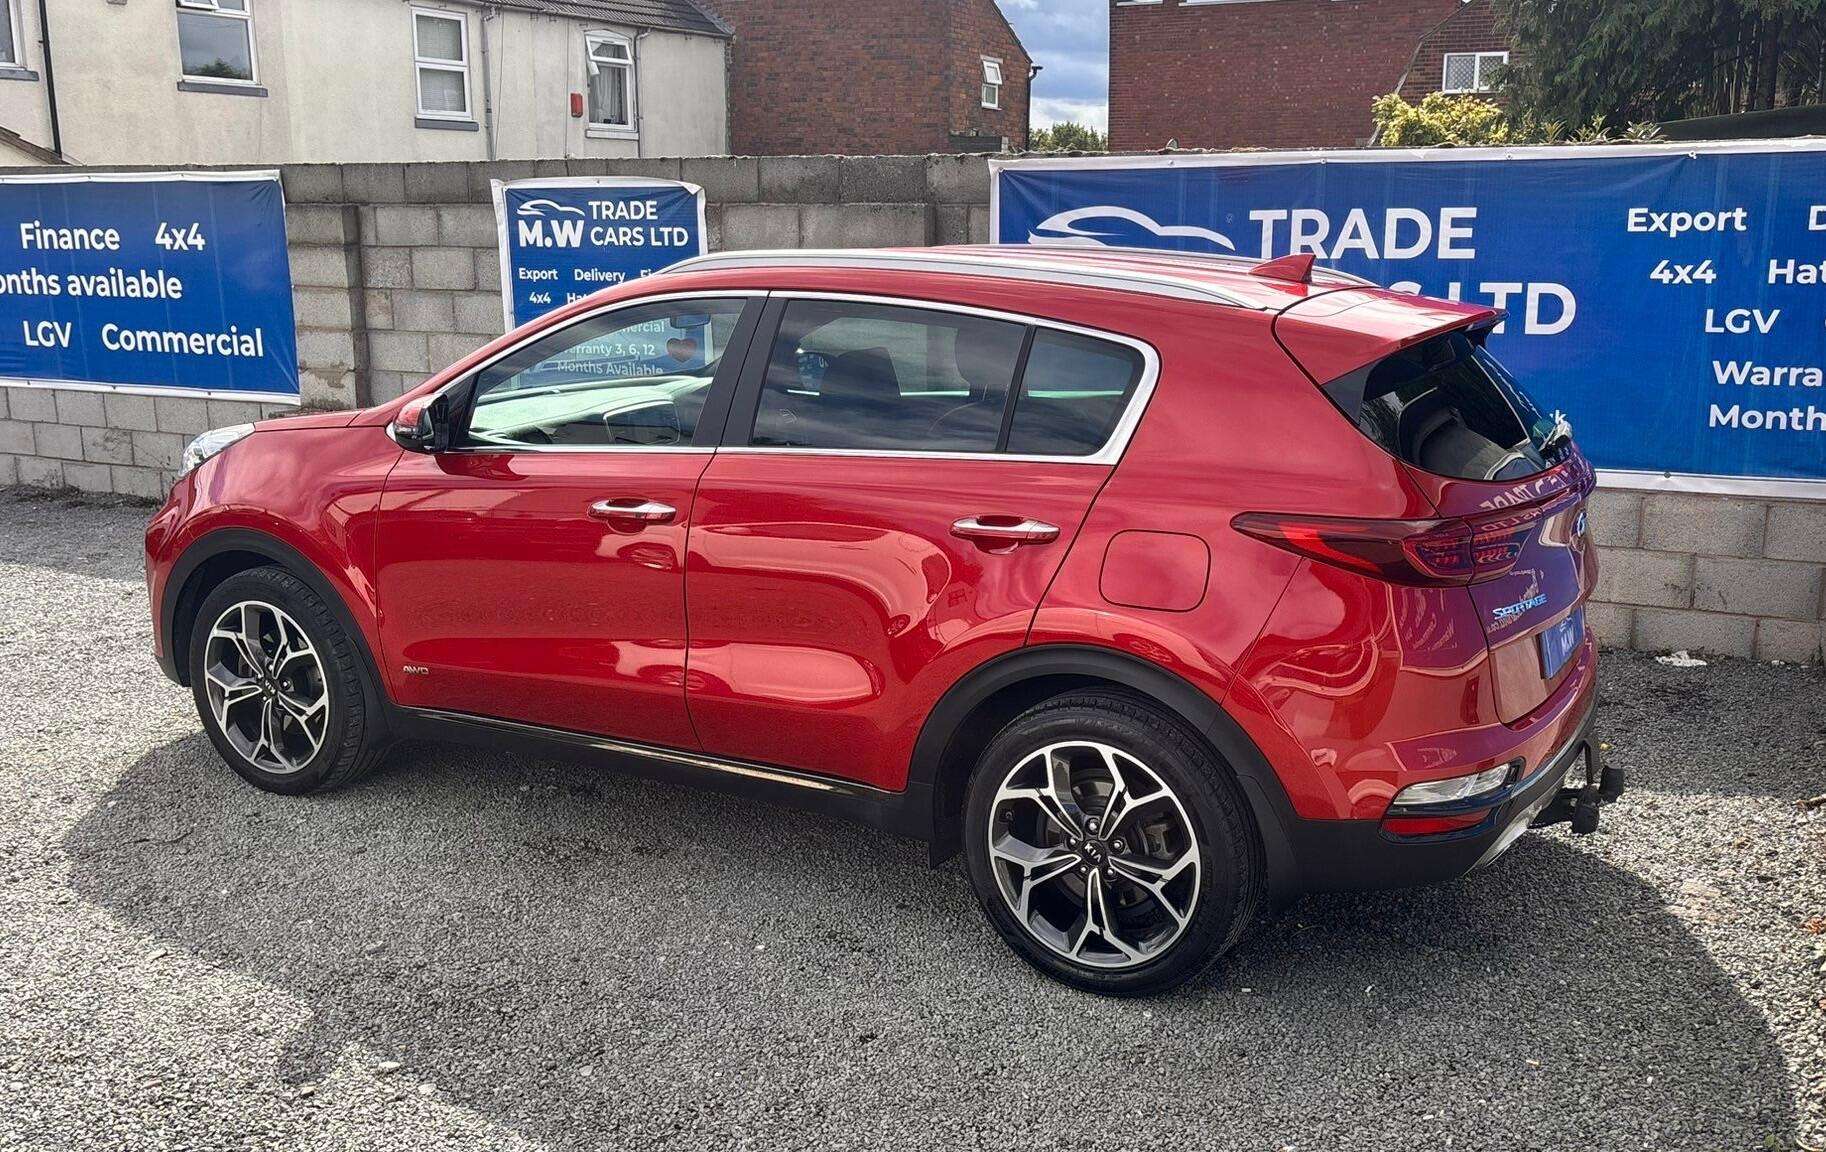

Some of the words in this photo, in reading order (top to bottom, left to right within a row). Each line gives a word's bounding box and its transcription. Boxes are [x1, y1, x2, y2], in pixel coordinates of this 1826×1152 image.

[588, 200, 658, 220] TRADE
[1627, 207, 1748, 237] Export
[20, 220, 121, 251] Finance
[154, 222, 206, 251] 4x4
[518, 220, 584, 248] M.W
[590, 227, 645, 247] CARS
[650, 227, 689, 247] LTD
[1249, 207, 1477, 260] TRADE
[67, 268, 183, 299] available
[518, 267, 559, 283] Export
[573, 268, 626, 285] Delivery
[1649, 259, 1717, 285] 4x4
[529, 291, 552, 304] 4x4
[1704, 308, 1781, 334] LGV
[23, 320, 72, 348] LGV
[101, 323, 265, 358] Commercial
[615, 344, 626, 357] 3,
[628, 344, 641, 356] 6,
[643, 344, 656, 356] 12
[1712, 360, 1823, 387] Warra
[1709, 403, 1826, 431] Month
[1491, 593, 1548, 620] SPORTAGE
[402, 665, 430, 675] AWD
